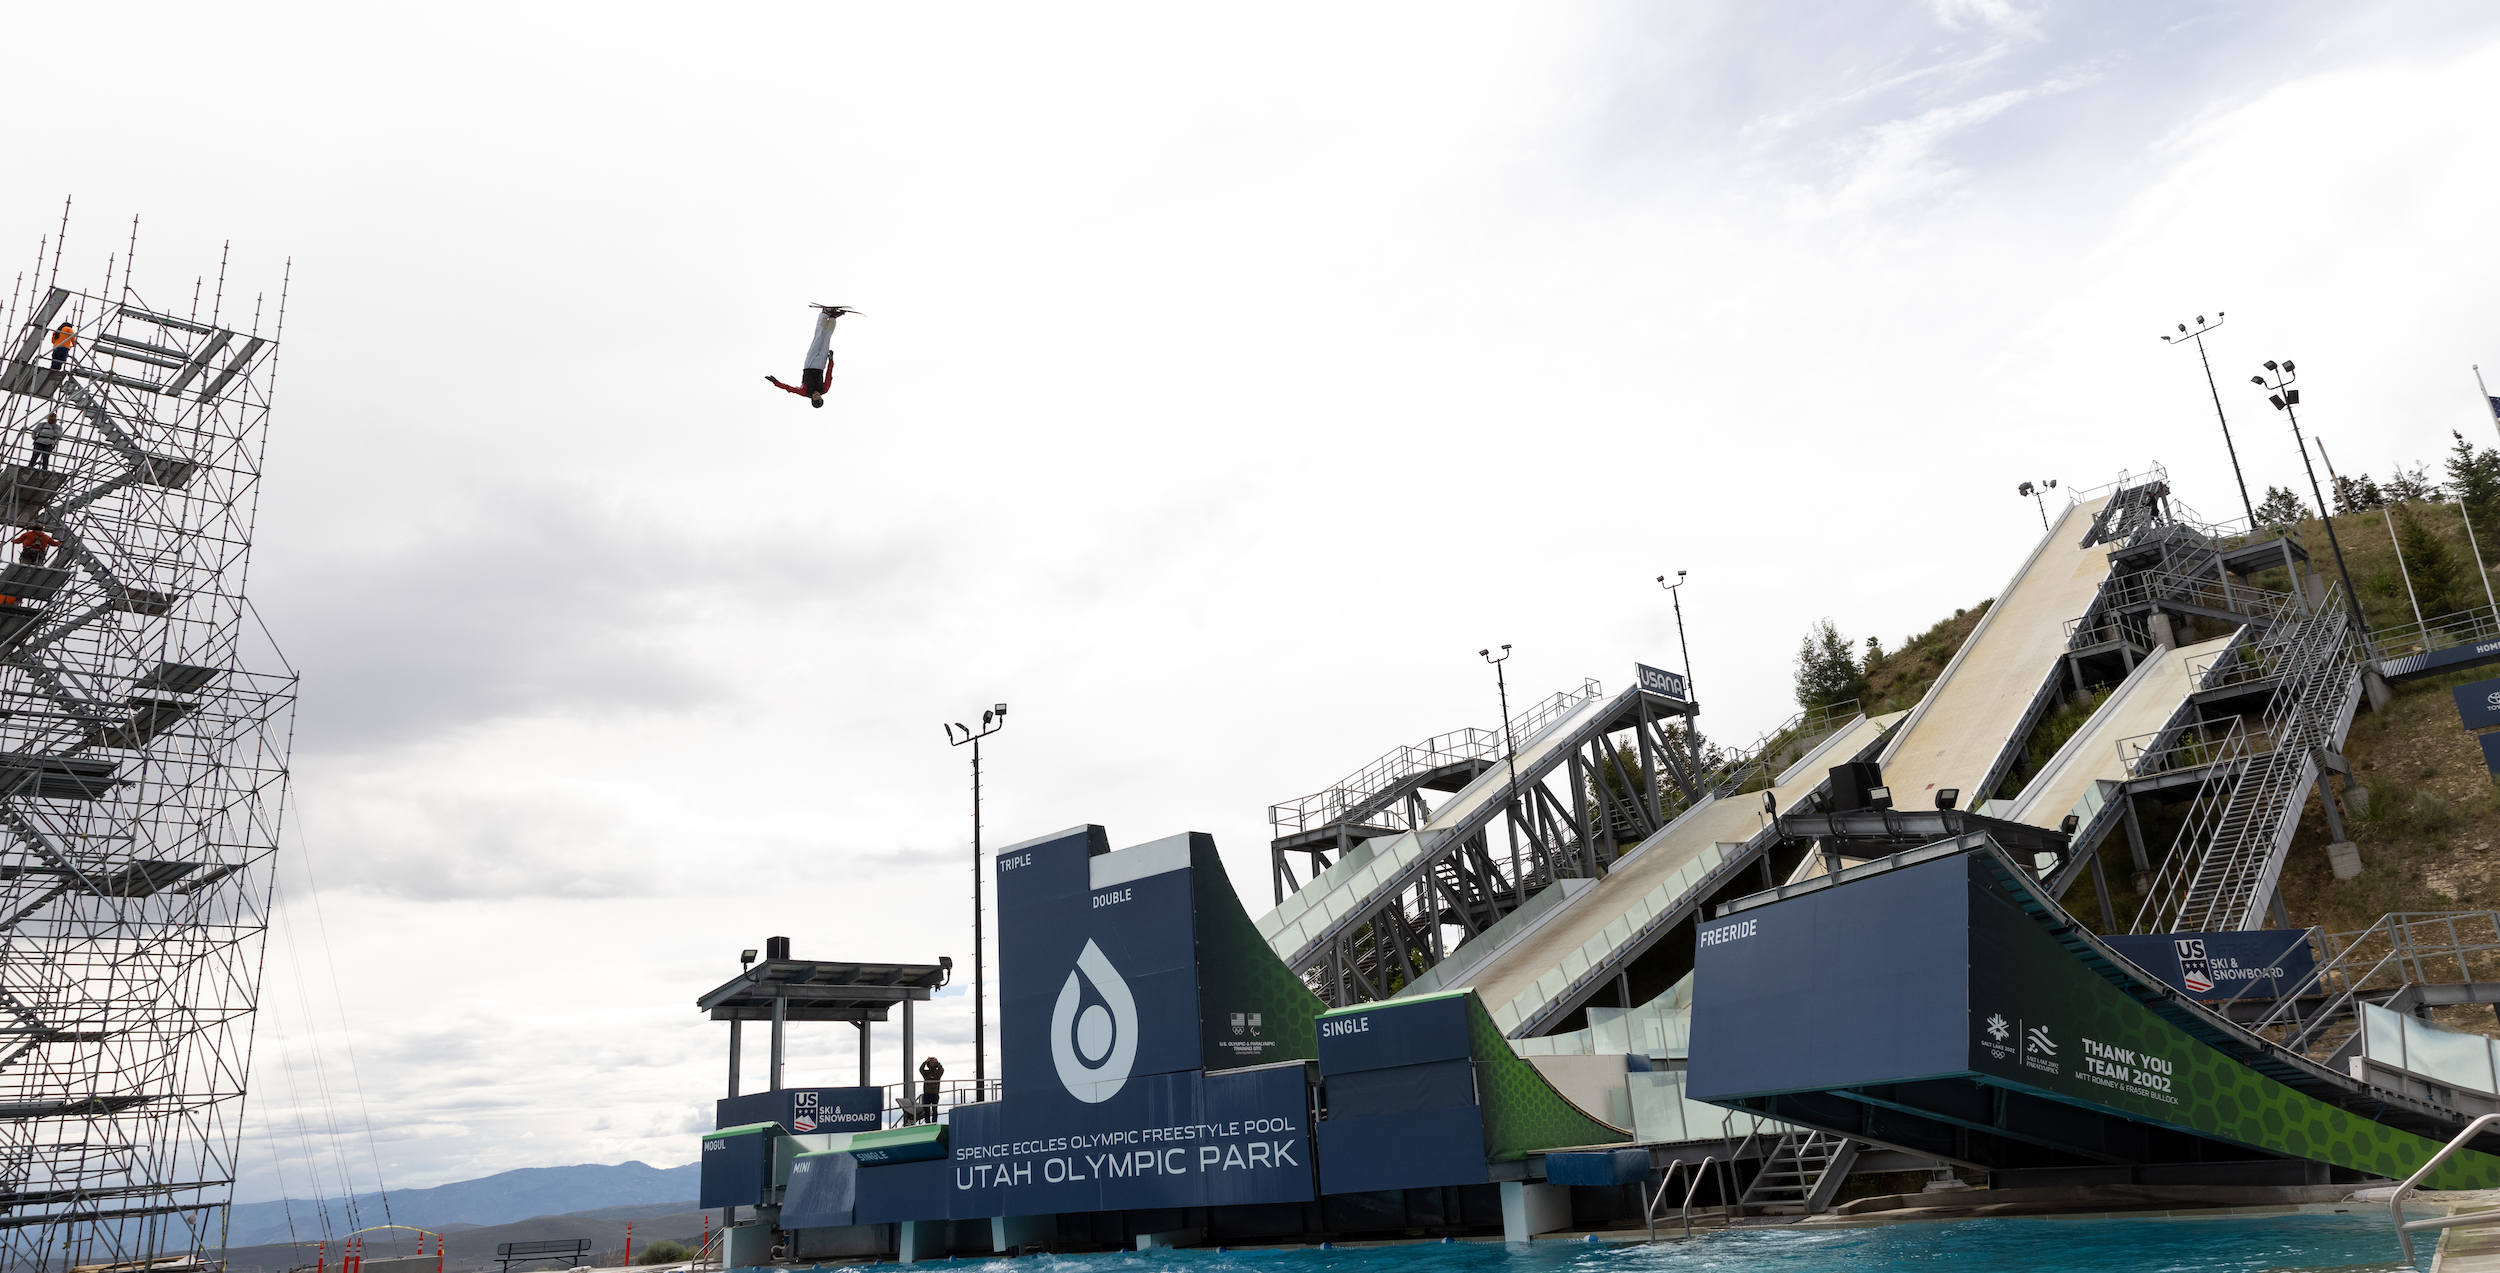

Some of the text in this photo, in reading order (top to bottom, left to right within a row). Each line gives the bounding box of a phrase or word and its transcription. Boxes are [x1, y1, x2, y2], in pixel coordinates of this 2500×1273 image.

[1640, 668, 1683, 695] USANA
[1000, 853, 1032, 872] TRIPLE
[1092, 888, 1132, 909] DOUBLE
[1700, 918, 1757, 948] FREERIDE
[2177, 940, 2204, 959] US
[2210, 958, 2228, 970] SKI
[2230, 957, 2238, 968] &
[1322, 1016, 1369, 1037] SINGLE
[1992, 1042, 2004, 1051] LAKE
[2004, 1046, 2015, 1054] 2002
[2081, 1038, 2172, 1075] THANK YOU
[2026, 1060, 2059, 1075] PARALYMPICS
[2036, 1057, 2047, 1065] LAKE
[2048, 1061, 2059, 1069] 2002
[2085, 1056, 2171, 1093] TEAM 2002
[2075, 1071, 2179, 1105] MITT ROMNEY & FRASER BULLOCK
[796, 1093, 817, 1107] US
[819, 1106, 842, 1115] SKI &
[819, 1113, 876, 1123] SNOWBOARD
[704, 1139, 726, 1152] MOGUL
[956, 1117, 1296, 1161] SPENCE ECCLES OLYMPIC FREESTYLE POOL
[856, 1150, 889, 1161] SINGLE
[956, 1139, 1298, 1190] UTAH OLYMPIC PARK
[793, 1161, 811, 1174] MINI
